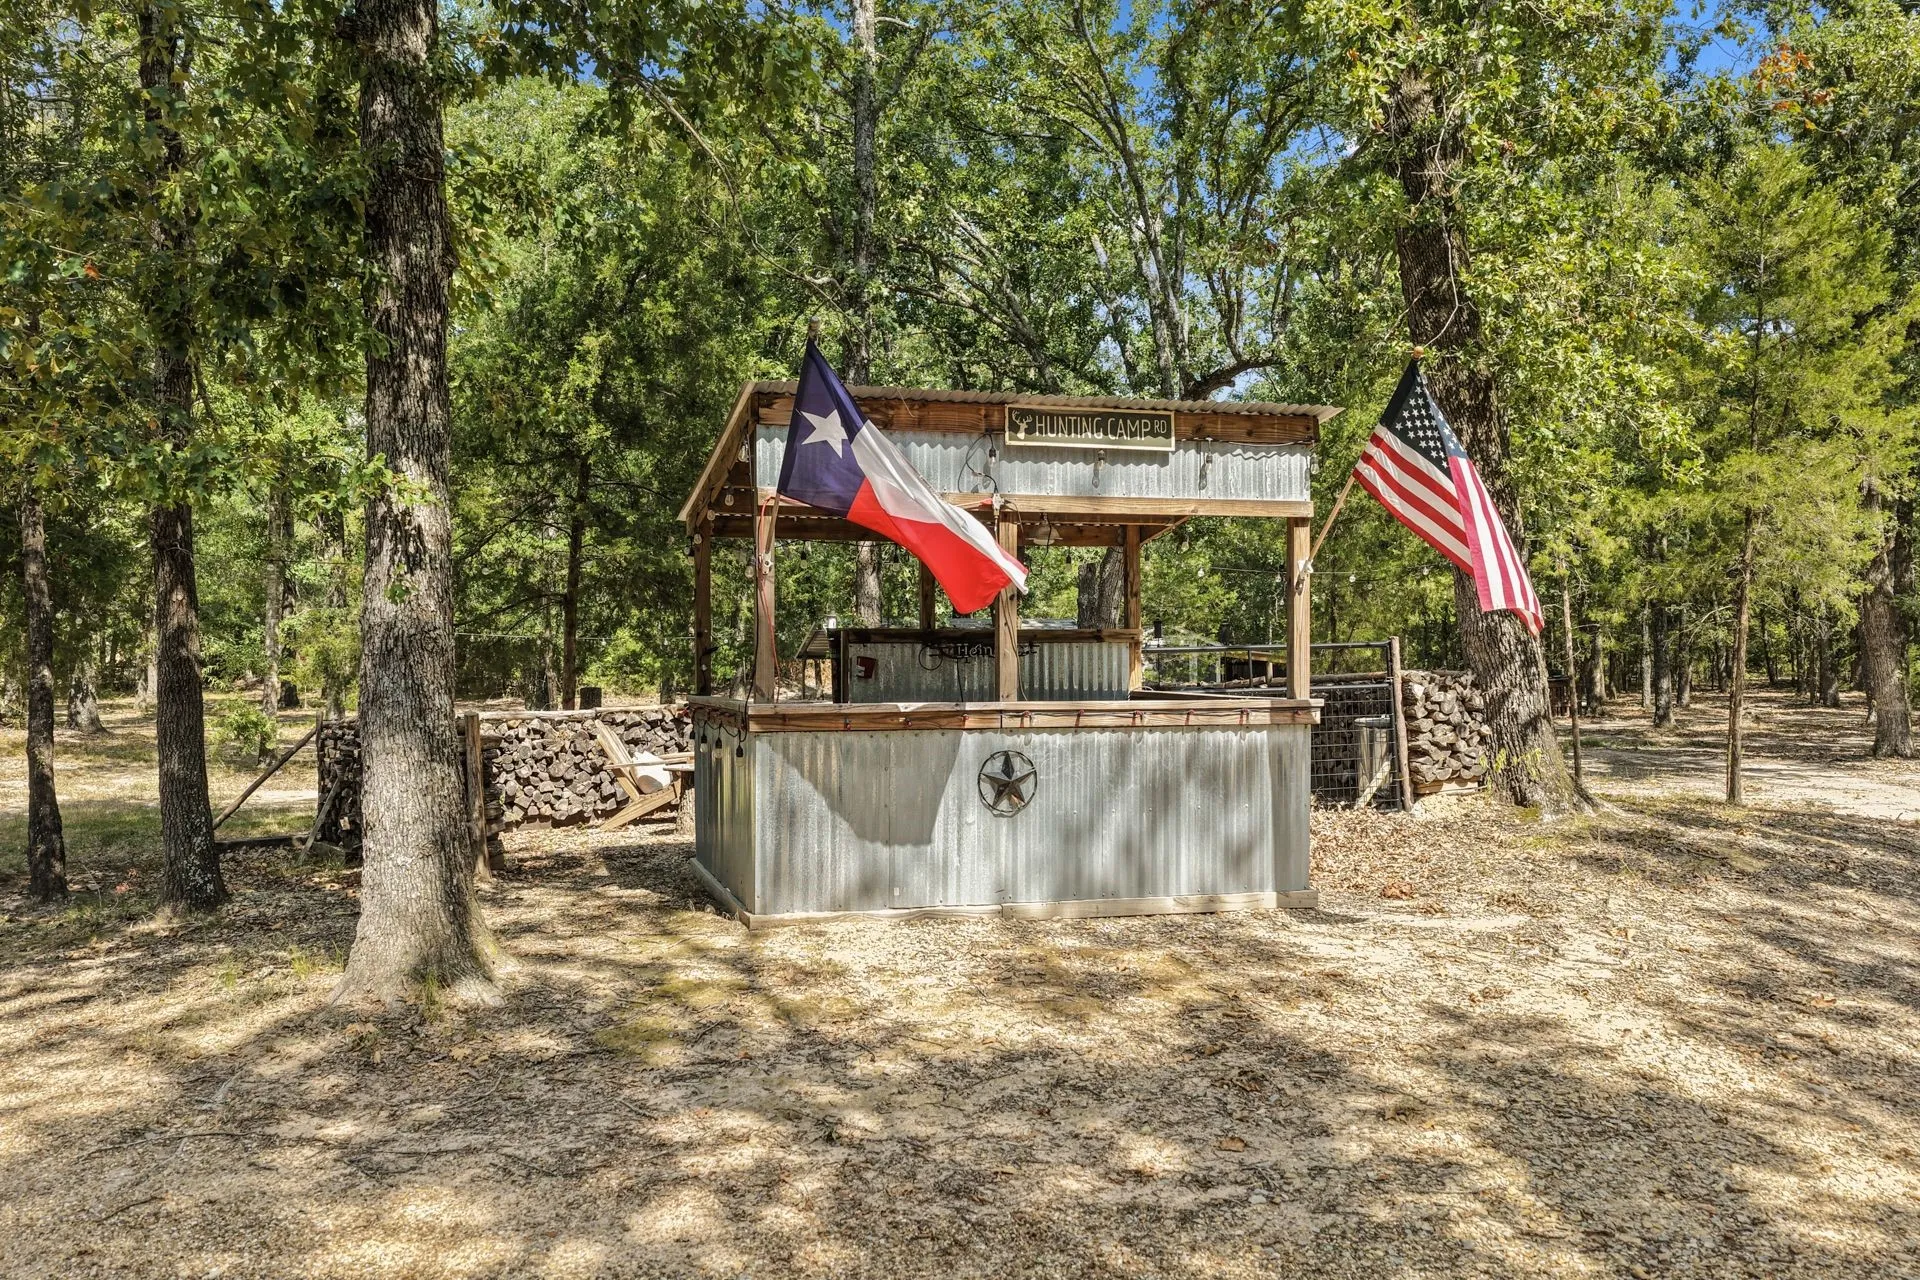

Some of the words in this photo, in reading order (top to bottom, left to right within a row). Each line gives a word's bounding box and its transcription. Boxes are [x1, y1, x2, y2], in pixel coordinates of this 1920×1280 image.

[1035, 415, 1103, 439] HUNTING
[1107, 417, 1151, 441] CAMP
[1154, 419, 1167, 434] RD
